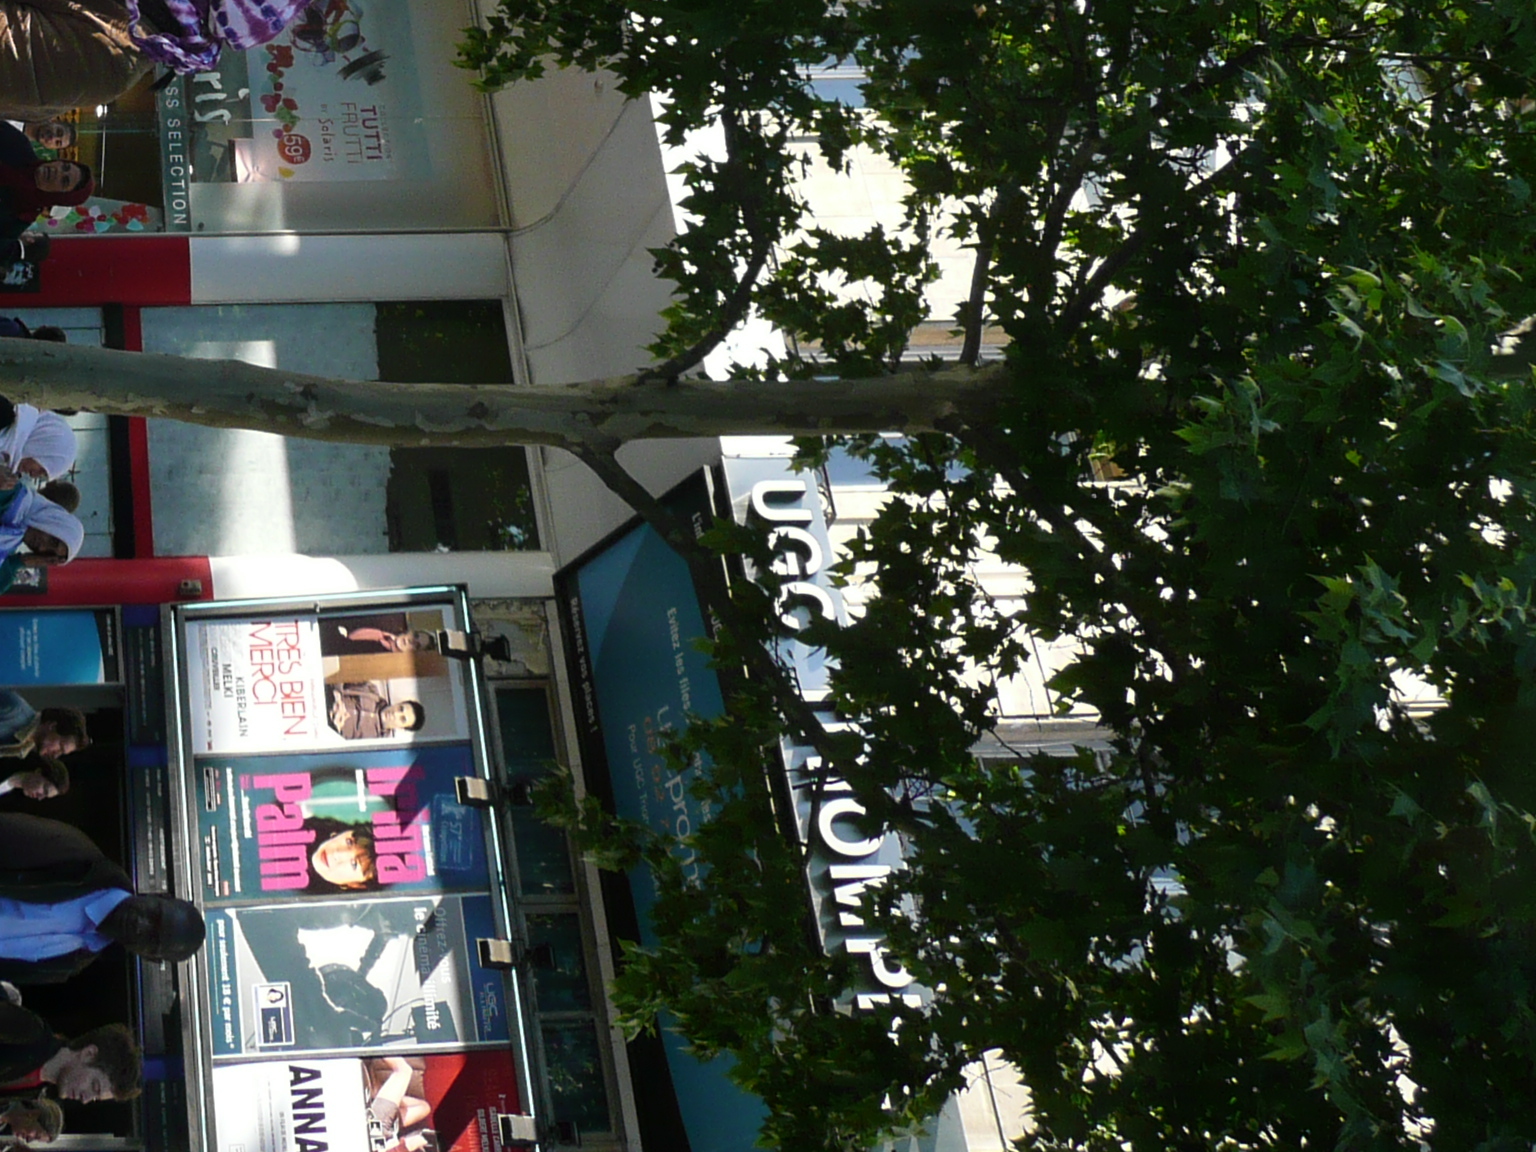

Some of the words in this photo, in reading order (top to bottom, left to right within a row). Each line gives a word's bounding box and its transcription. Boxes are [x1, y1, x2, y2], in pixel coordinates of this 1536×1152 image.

[318, 118, 337, 162] Solaris
[340, 102, 363, 164] FRUTTI
[360, 105, 383, 160] TUTTI
[167, 118, 187, 224] SELECTION
[751, 480, 835, 630] UGC
[570, 597, 584, 654] Réservez
[667, 607, 680, 650] Evitez
[222, 663, 233, 698] MELKI
[249, 620, 278, 705] MERCI
[579, 656, 588, 679] vos
[674, 654, 685, 675] les
[235, 676, 248, 737] KIBERLAIN
[581, 681, 596, 724] places
[678, 677, 691, 710] files
[627, 724, 637, 754] Pour
[633, 758, 645, 790] UGC
[253, 772, 317, 891] Palm
[366, 766, 430, 884] Irina
[216, 919, 228, 938] pour
[414, 907, 427, 921] le
[218, 940, 231, 981] seulement
[416, 924, 432, 974] cinéma
[434, 907, 451, 984] Offrez-vous
[221, 983, 232, 995] 18
[223, 997, 232, 1005] €
[422, 979, 441, 1030] illimité
[485, 982, 498, 1016] UGC
[221, 1007, 233, 1020] par
[288, 1065, 329, 1152] ANNA
